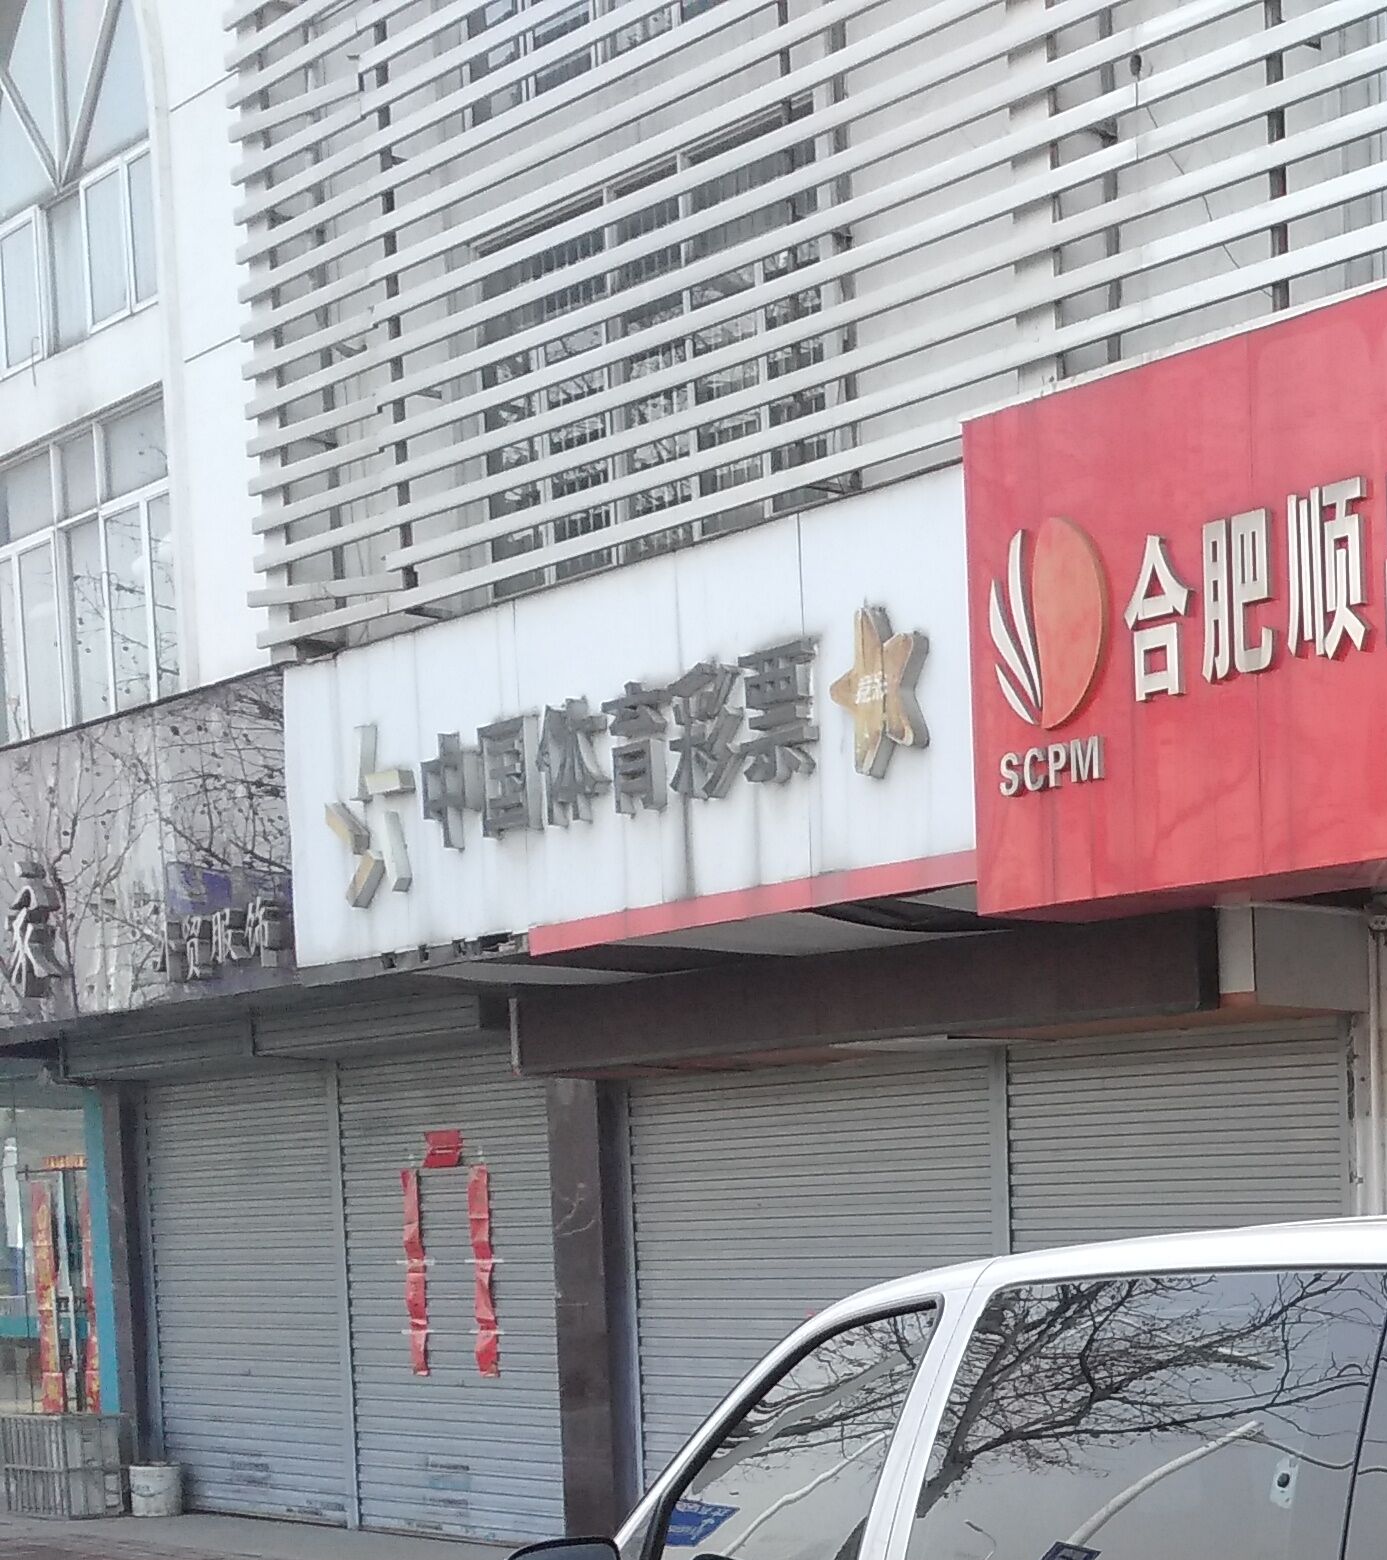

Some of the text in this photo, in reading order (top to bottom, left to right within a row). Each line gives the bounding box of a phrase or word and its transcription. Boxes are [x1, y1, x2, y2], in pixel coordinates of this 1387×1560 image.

[421, 638, 820, 852] 中国体育彩票
[1000, 736, 1104, 797] SCPM
